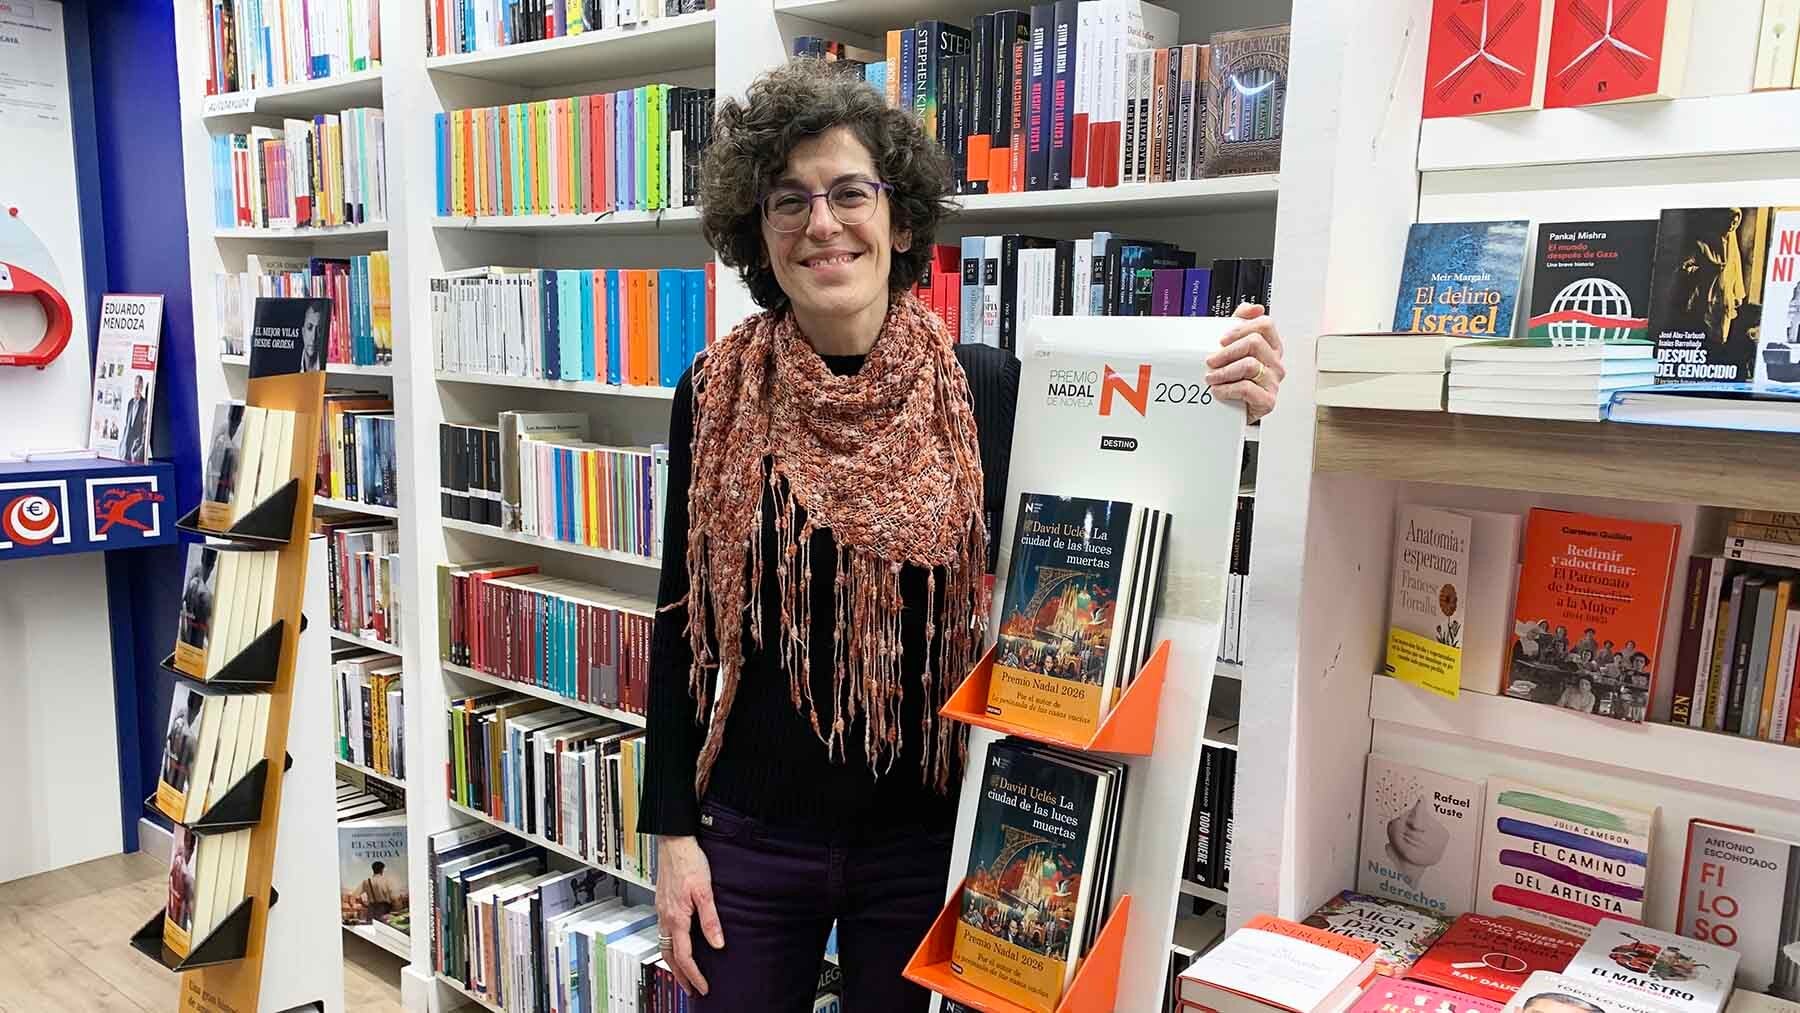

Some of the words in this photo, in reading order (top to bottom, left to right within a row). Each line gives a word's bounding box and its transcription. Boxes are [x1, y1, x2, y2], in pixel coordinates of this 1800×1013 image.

[917, 29, 928, 92] STEPHEN
[1032, 50, 1043, 77] VICENTE
[1056, 47, 1067, 74] VICENTE
[1166, 125, 1174, 171] BLACKWATER
[1549, 231, 1576, 241] Pankaj
[1577, 231, 1607, 240] Mishra
[1431, 272, 1453, 281] Meir
[1453, 272, 1491, 283] Margalit
[1772, 256, 1795, 282] NI
[1415, 286, 1435, 305] El
[1438, 285, 1501, 305] delirio
[105, 303, 145, 316] EDUARDO
[1408, 305, 1498, 335] Israel
[103, 318, 145, 330] MENDOZA
[255, 327, 262, 336] EL
[263, 327, 281, 338] MEJOR
[281, 328, 299, 338] VILAS
[254, 339, 272, 348] DESDE
[272, 339, 295, 349] ORDESA
[1657, 347, 1707, 364] DESPUÉS
[1050, 369, 1098, 384] PREMIO
[1656, 363, 1676, 378] DEL
[1677, 364, 1738, 379] GENOCIDIO
[1047, 383, 1095, 398] NADAL
[1098, 363, 1152, 417] N
[1154, 382, 1213, 405] 2026
[1047, 397, 1057, 406] DE
[1059, 398, 1094, 408] NOVELA
[1103, 439, 1135, 449] DESTINO
[1025, 502, 1034, 513] N
[1033, 520, 1060, 535] David
[1063, 523, 1089, 539] Uclé
[1094, 527, 1108, 541] La
[1021, 533, 1051, 547] ciudad
[1053, 537, 1065, 549] de
[1067, 538, 1082, 551] las
[1085, 540, 1112, 555] luces
[1567, 543, 1623, 562] Redimir
[1066, 554, 1110, 569] muertas
[1402, 547, 1458, 576] esperanza
[1560, 556, 1638, 576] adoctrinar:
[1547, 581, 1563, 593] de
[1553, 567, 1566, 580] El
[1568, 569, 1630, 589] Patronato
[1566, 596, 1577, 608] la
[1580, 599, 1618, 616] Mujer
[1001, 671, 1031, 688] Premio
[1032, 679, 1059, 694] Nadal
[1061, 686, 1085, 700] 2026
[991, 756, 1001, 767] N
[999, 777, 1027, 796] David
[1029, 786, 1057, 806] Uclés
[1059, 795, 1074, 811] La
[1434, 791, 1470, 808] Rafael
[987, 788, 1018, 807] ciudad
[1019, 798, 1032, 812] de
[1033, 802, 1049, 817] las
[1051, 807, 1079, 827] luces
[1433, 803, 1463, 819] Yuste
[1032, 819, 1076, 840] muertas
[1199, 810, 1211, 834] TODO
[1553, 819, 1580, 833] JULIA
[1583, 827, 1630, 845] CAMERON
[366, 837, 403, 849] SUEÑO
[367, 849, 400, 858] TROYA
[1196, 835, 1209, 865] MUERE
[1705, 837, 1755, 854] ANTONIO
[1532, 841, 1547, 854] EL
[1557, 848, 1626, 878] CAMINO
[1704, 847, 1777, 871] ESCOHOTADO
[1367, 859, 1413, 885] Neuro
[1700, 862, 1725, 887] FI
[1379, 879, 1448, 911] derechos
[1515, 872, 1542, 891] DEL
[1551, 884, 1624, 914] ARTISTA
[1697, 889, 1739, 918] LO
[1346, 908, 1415, 930] Alicia
[1487, 927, 1512, 937] LOS
[1516, 929, 1582, 949] QUIEBRAN
[1694, 917, 1738, 947] SO
[963, 929, 992, 950] Premio
[993, 943, 1019, 962] Nadal
[1021, 955, 1044, 972] 2026
[1451, 970, 1477, 982] RAY
[1591, 966, 1613, 978] EL
[1612, 972, 1695, 1002] MAESTRO
